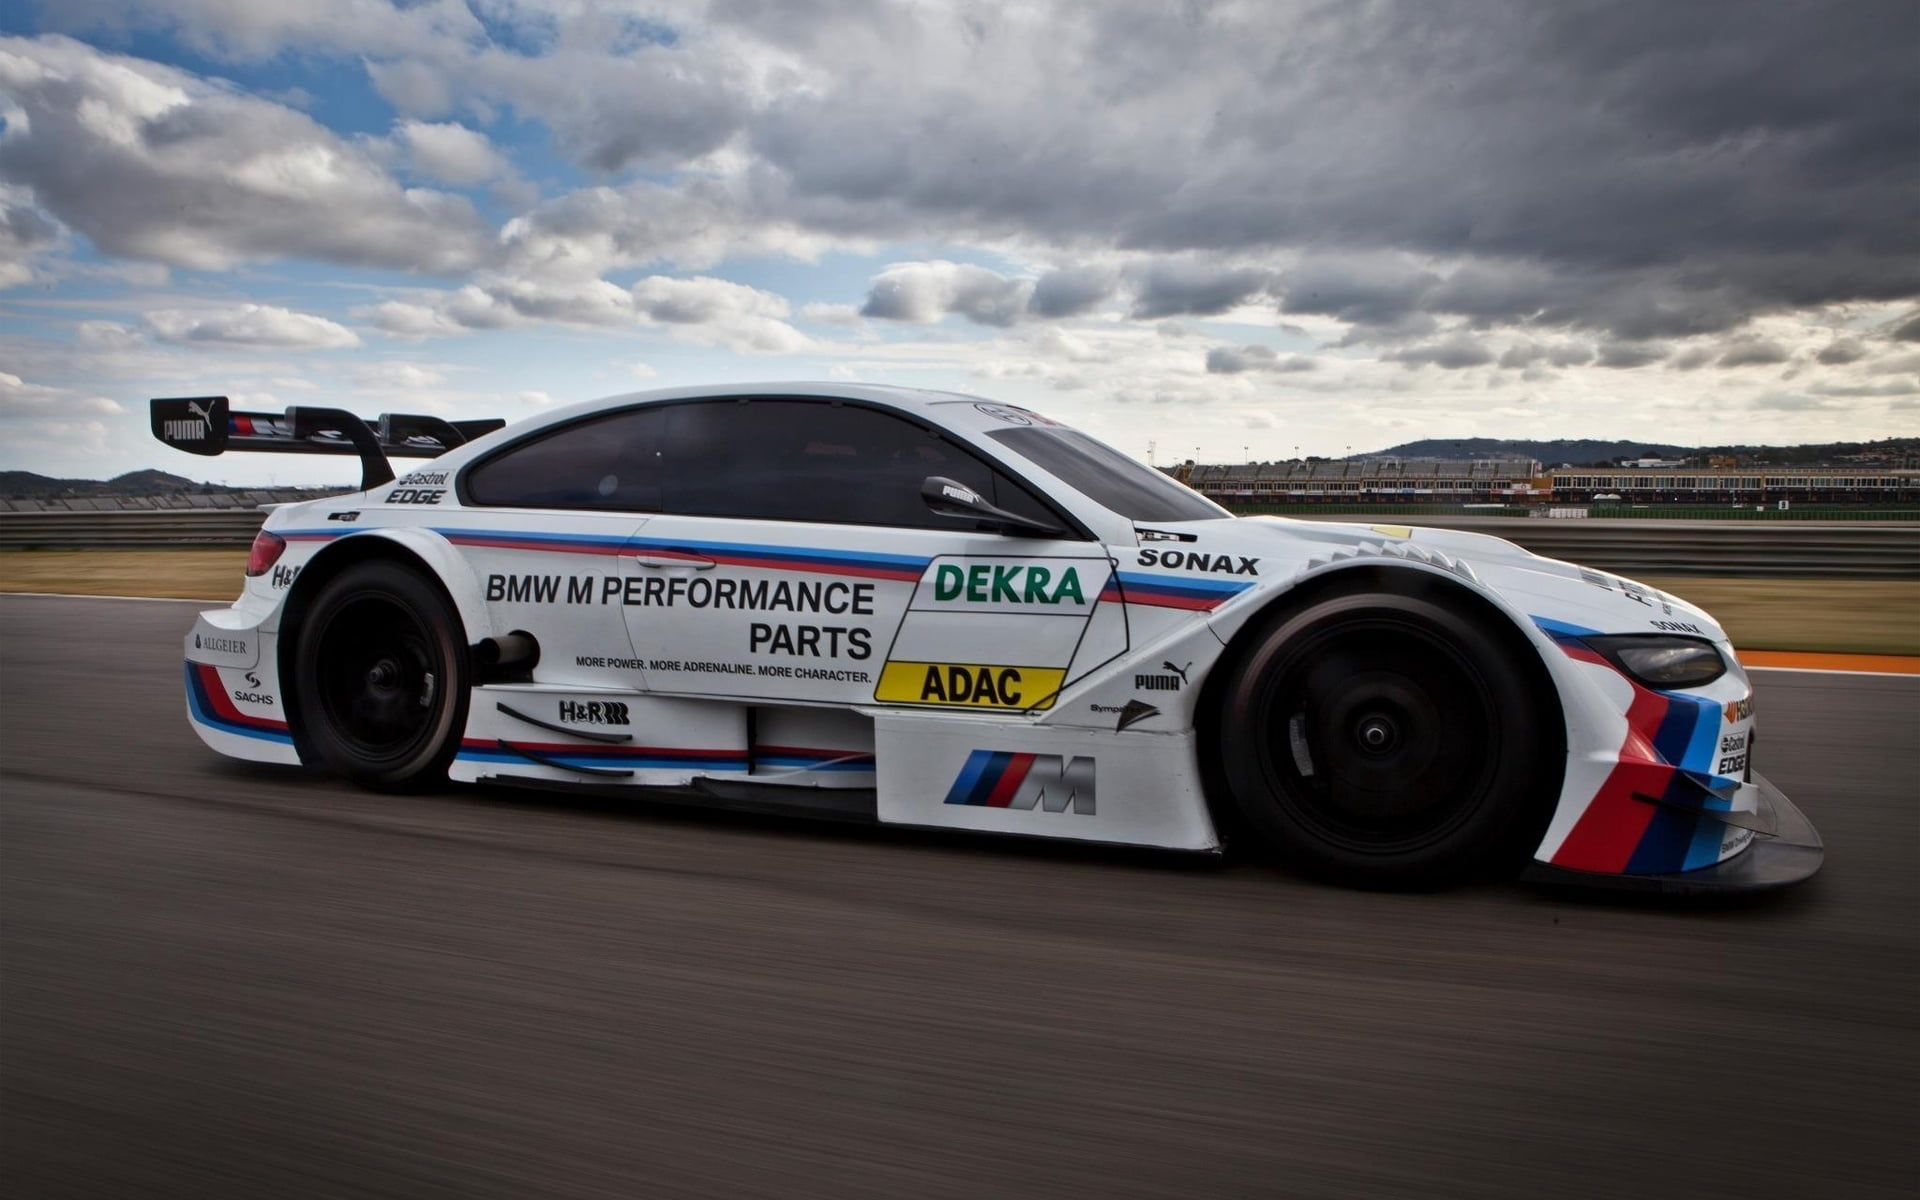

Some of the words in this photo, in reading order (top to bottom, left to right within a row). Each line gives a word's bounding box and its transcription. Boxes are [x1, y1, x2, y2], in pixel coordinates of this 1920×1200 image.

[164, 419, 205, 440] PUMA
[409, 472, 449, 485] Castrol
[385, 489, 448, 505] EDGE
[942, 485, 974, 504] PUMA
[1137, 548, 1261, 576] SONAX
[486, 574, 561, 604] BMW
[567, 576, 594, 605] M
[602, 577, 875, 616] PERFORMANCE
[935, 564, 1085, 605] DEKRA
[1649, 620, 1705, 635] SONAX
[203, 638, 247, 655] ALLGEIER
[750, 623, 873, 661] PARTS
[576, 656, 605, 669] MORE
[607, 658, 647, 671] POWER.
[650, 660, 682, 672] MORE
[683, 661, 756, 676] ADRENALINE.
[758, 665, 793, 678] MORE
[794, 667, 872, 684] CHARACTER.
[920, 665, 1022, 705] ADAC
[1135, 675, 1180, 691] PUMA
[234, 690, 274, 705] SACHS
[1718, 754, 1745, 775] EDGE
